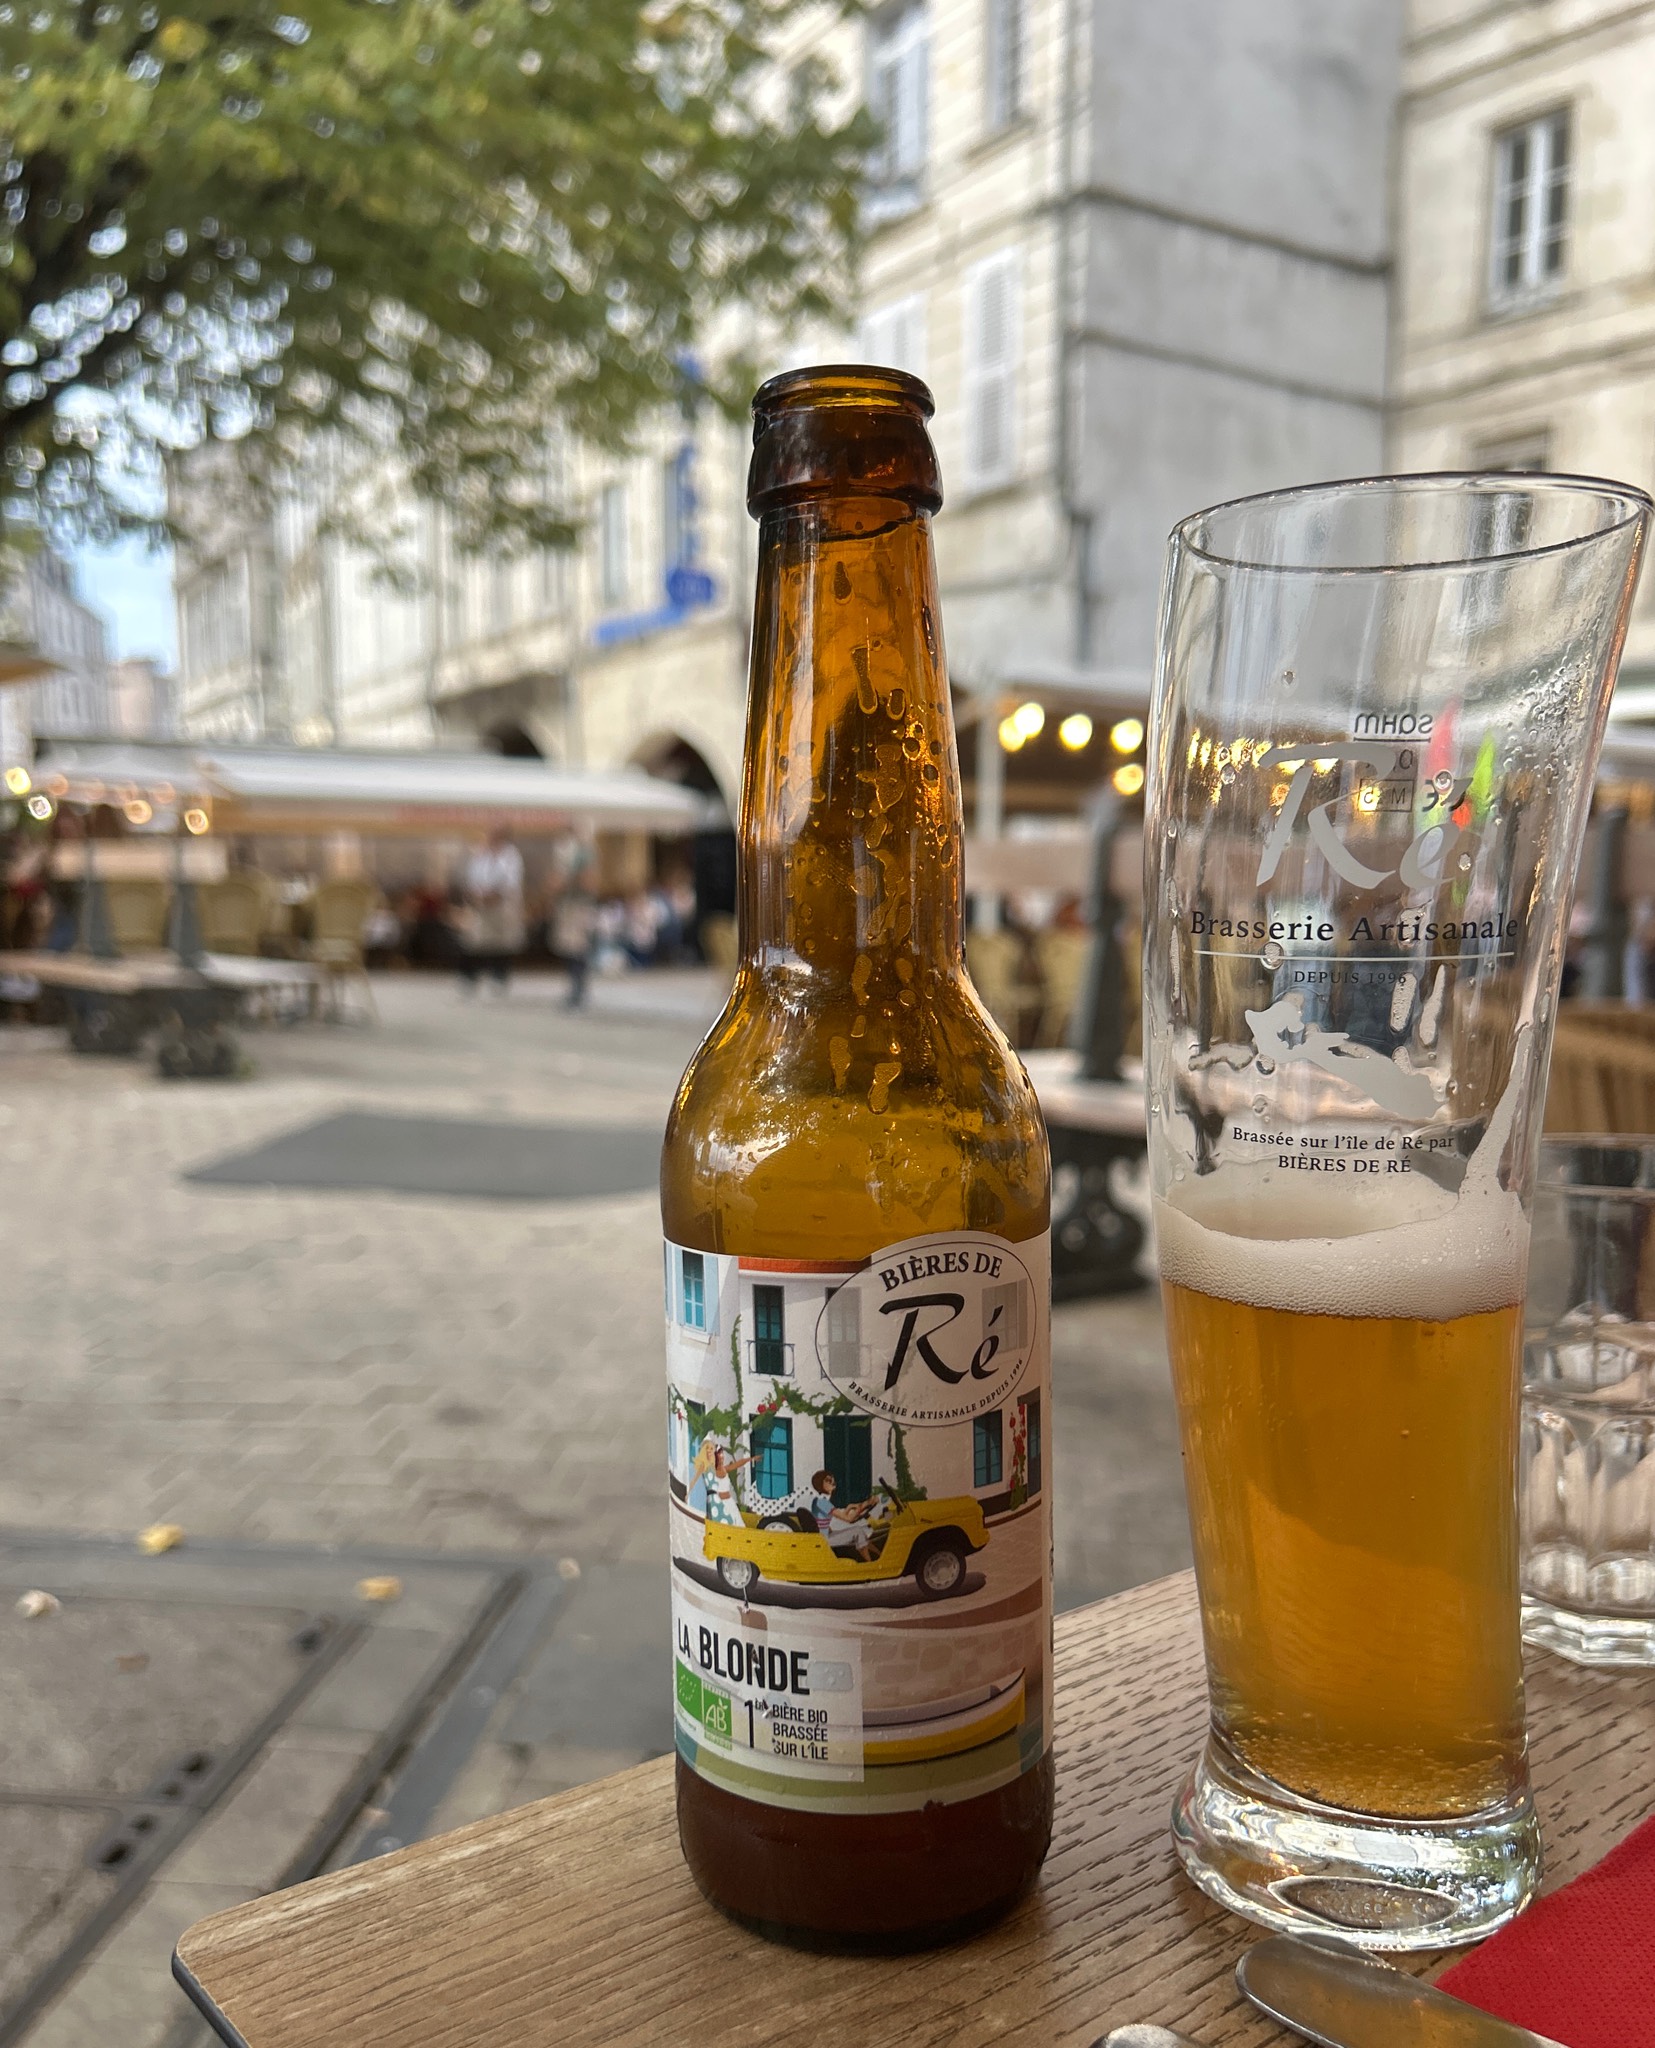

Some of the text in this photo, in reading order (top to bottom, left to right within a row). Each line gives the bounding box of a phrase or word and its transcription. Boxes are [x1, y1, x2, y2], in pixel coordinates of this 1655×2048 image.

[1191, 911, 1518, 941] Brasserie Artisanale
[1294, 971, 1407, 984] DEPUIS 1996
[1232, 1127, 1294, 1147] Brassée
[1300, 1135, 1329, 1149] sur
[1374, 1136, 1395, 1150] de
[1402, 1135, 1424, 1150] Ré
[1429, 1136, 1455, 1152] par
[1278, 1153, 1412, 1173] BIÈRES DE RÉ
[878, 1251, 1003, 1292] BIÈRES DE
[878, 1292, 1004, 1391] Ré
[849, 1358, 1023, 1420] BRASSERIE ARTISANALE DEPUIS 1996
[677, 1617, 811, 1696] LA BLONDE
[705, 1703, 728, 1732] AB
[772, 1701, 805, 1723] BIÈRE
[808, 1708, 828, 1724] BIO
[773, 1721, 828, 1743] BRASSÉE
[773, 1740, 798, 1758] SUR
